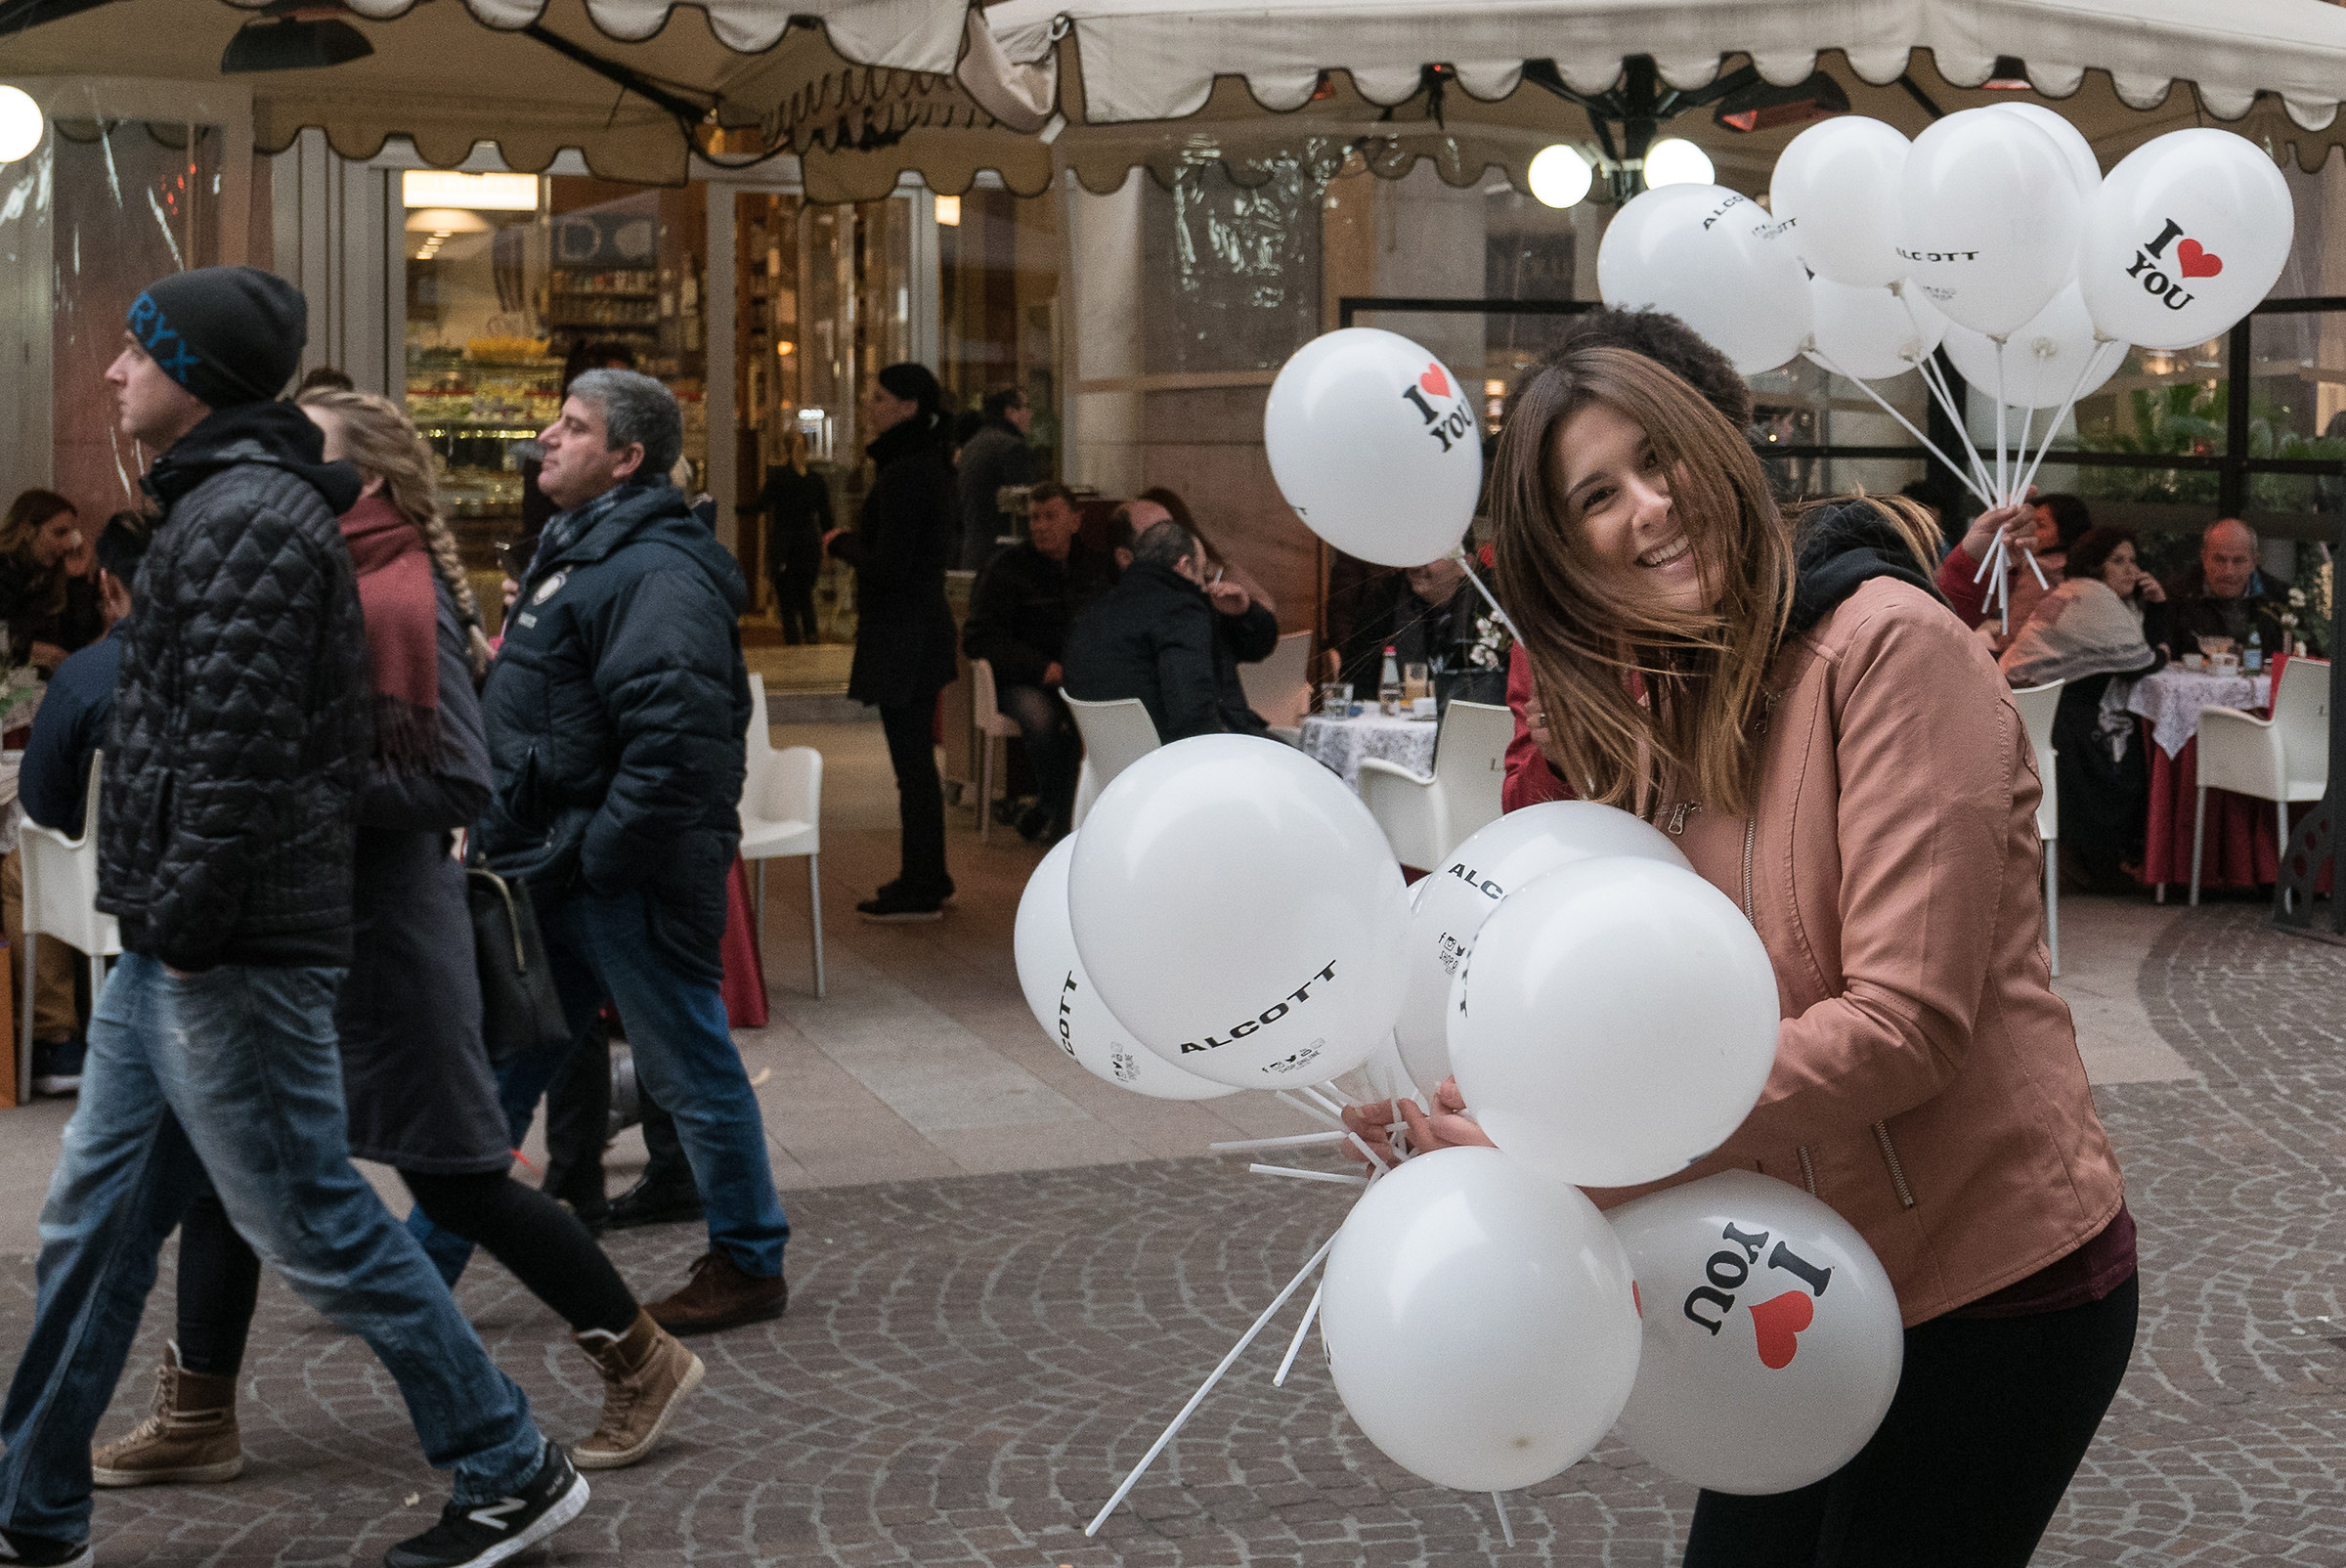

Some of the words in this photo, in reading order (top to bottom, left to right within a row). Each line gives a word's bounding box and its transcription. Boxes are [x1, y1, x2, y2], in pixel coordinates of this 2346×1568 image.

[2144, 217, 2184, 260] I
[2125, 250, 2194, 310] YOU
[1403, 384, 1439, 425] I
[1449, 863, 1509, 901] ALC
[1180, 959, 1336, 1054] ALCOTT
[1683, 1222, 1769, 1336] YOU
[1767, 1241, 1832, 1297] I
